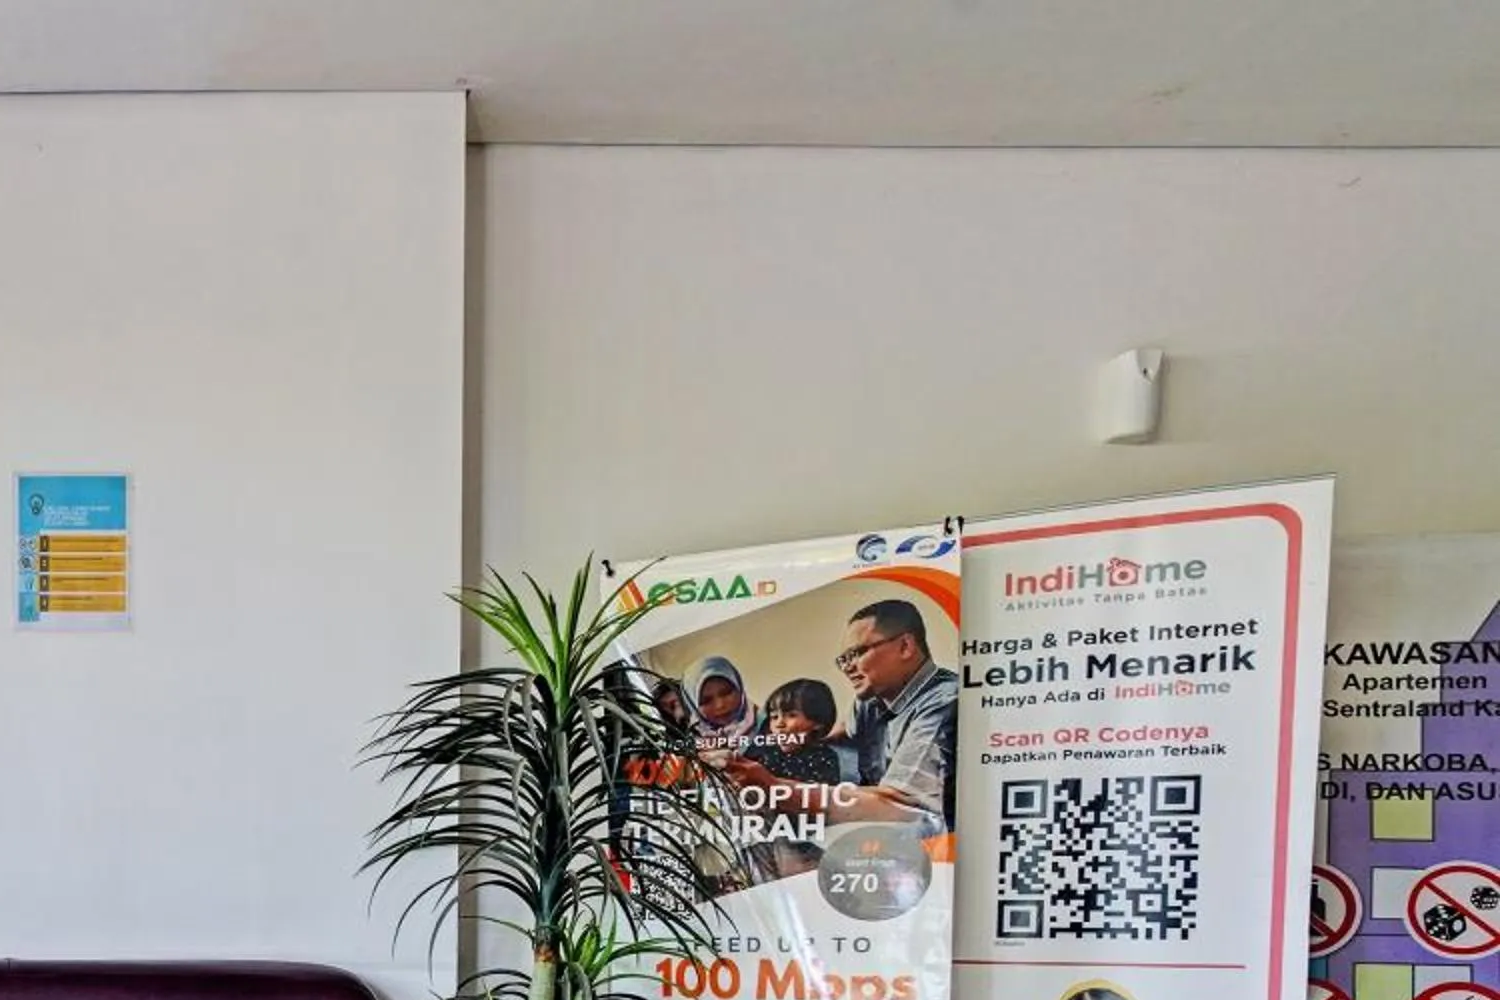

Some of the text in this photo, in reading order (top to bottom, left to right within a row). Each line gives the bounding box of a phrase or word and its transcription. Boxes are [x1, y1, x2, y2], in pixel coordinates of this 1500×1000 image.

[1003, 587, 1208, 612] Aktivitas Tanpa Batas
[961, 619, 1259, 656] Harga & Paket Internet
[1324, 641, 1500, 665] KAWASAN
[962, 645, 1256, 688] Lebih Menarik
[1342, 673, 1487, 694] Apartemen
[981, 695, 1037, 709] Hanya
[1043, 690, 1081, 703] Ada
[1087, 687, 1105, 701] di
[1323, 699, 1465, 718] Sentraland
[696, 735, 750, 749] SUPER
[753, 733, 807, 747] CEPAT
[989, 725, 1209, 747] Scan QR Codenya
[981, 743, 1227, 764] Dapatkan Penawaran Terbaik
[1341, 753, 1496, 774] NARKOBA,
[739, 781, 859, 811] OPTIC
[1366, 782, 1425, 800] DAN
[1434, 782, 1500, 801] ASU
[830, 873, 879, 893] 270
[832, 937, 871, 953] TO
[655, 957, 741, 999] 100
